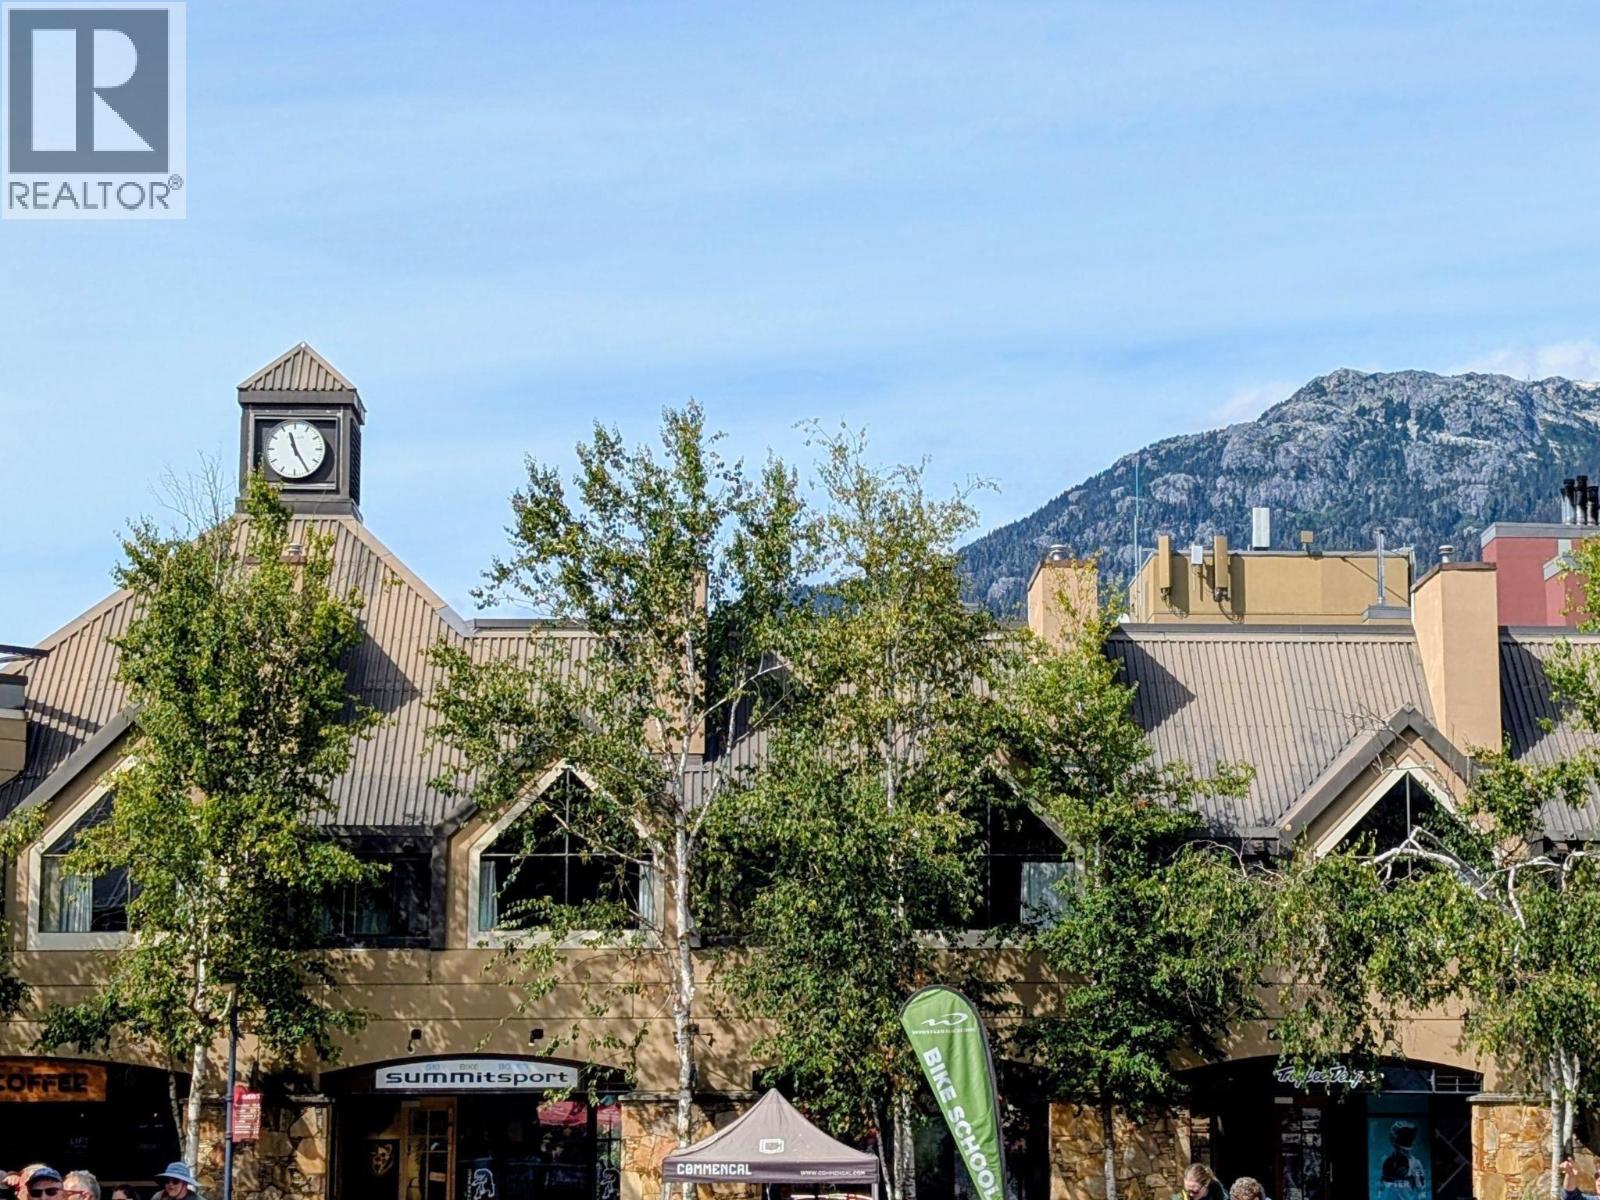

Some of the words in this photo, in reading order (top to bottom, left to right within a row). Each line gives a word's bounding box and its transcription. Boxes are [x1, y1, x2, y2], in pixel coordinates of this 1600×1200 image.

[385, 1072, 569, 1086] summitsport
[923, 1047, 957, 1103] BIKE
[948, 1105, 1000, 1200] SCHOOL
[676, 1163, 752, 1176] COMMENCAL
